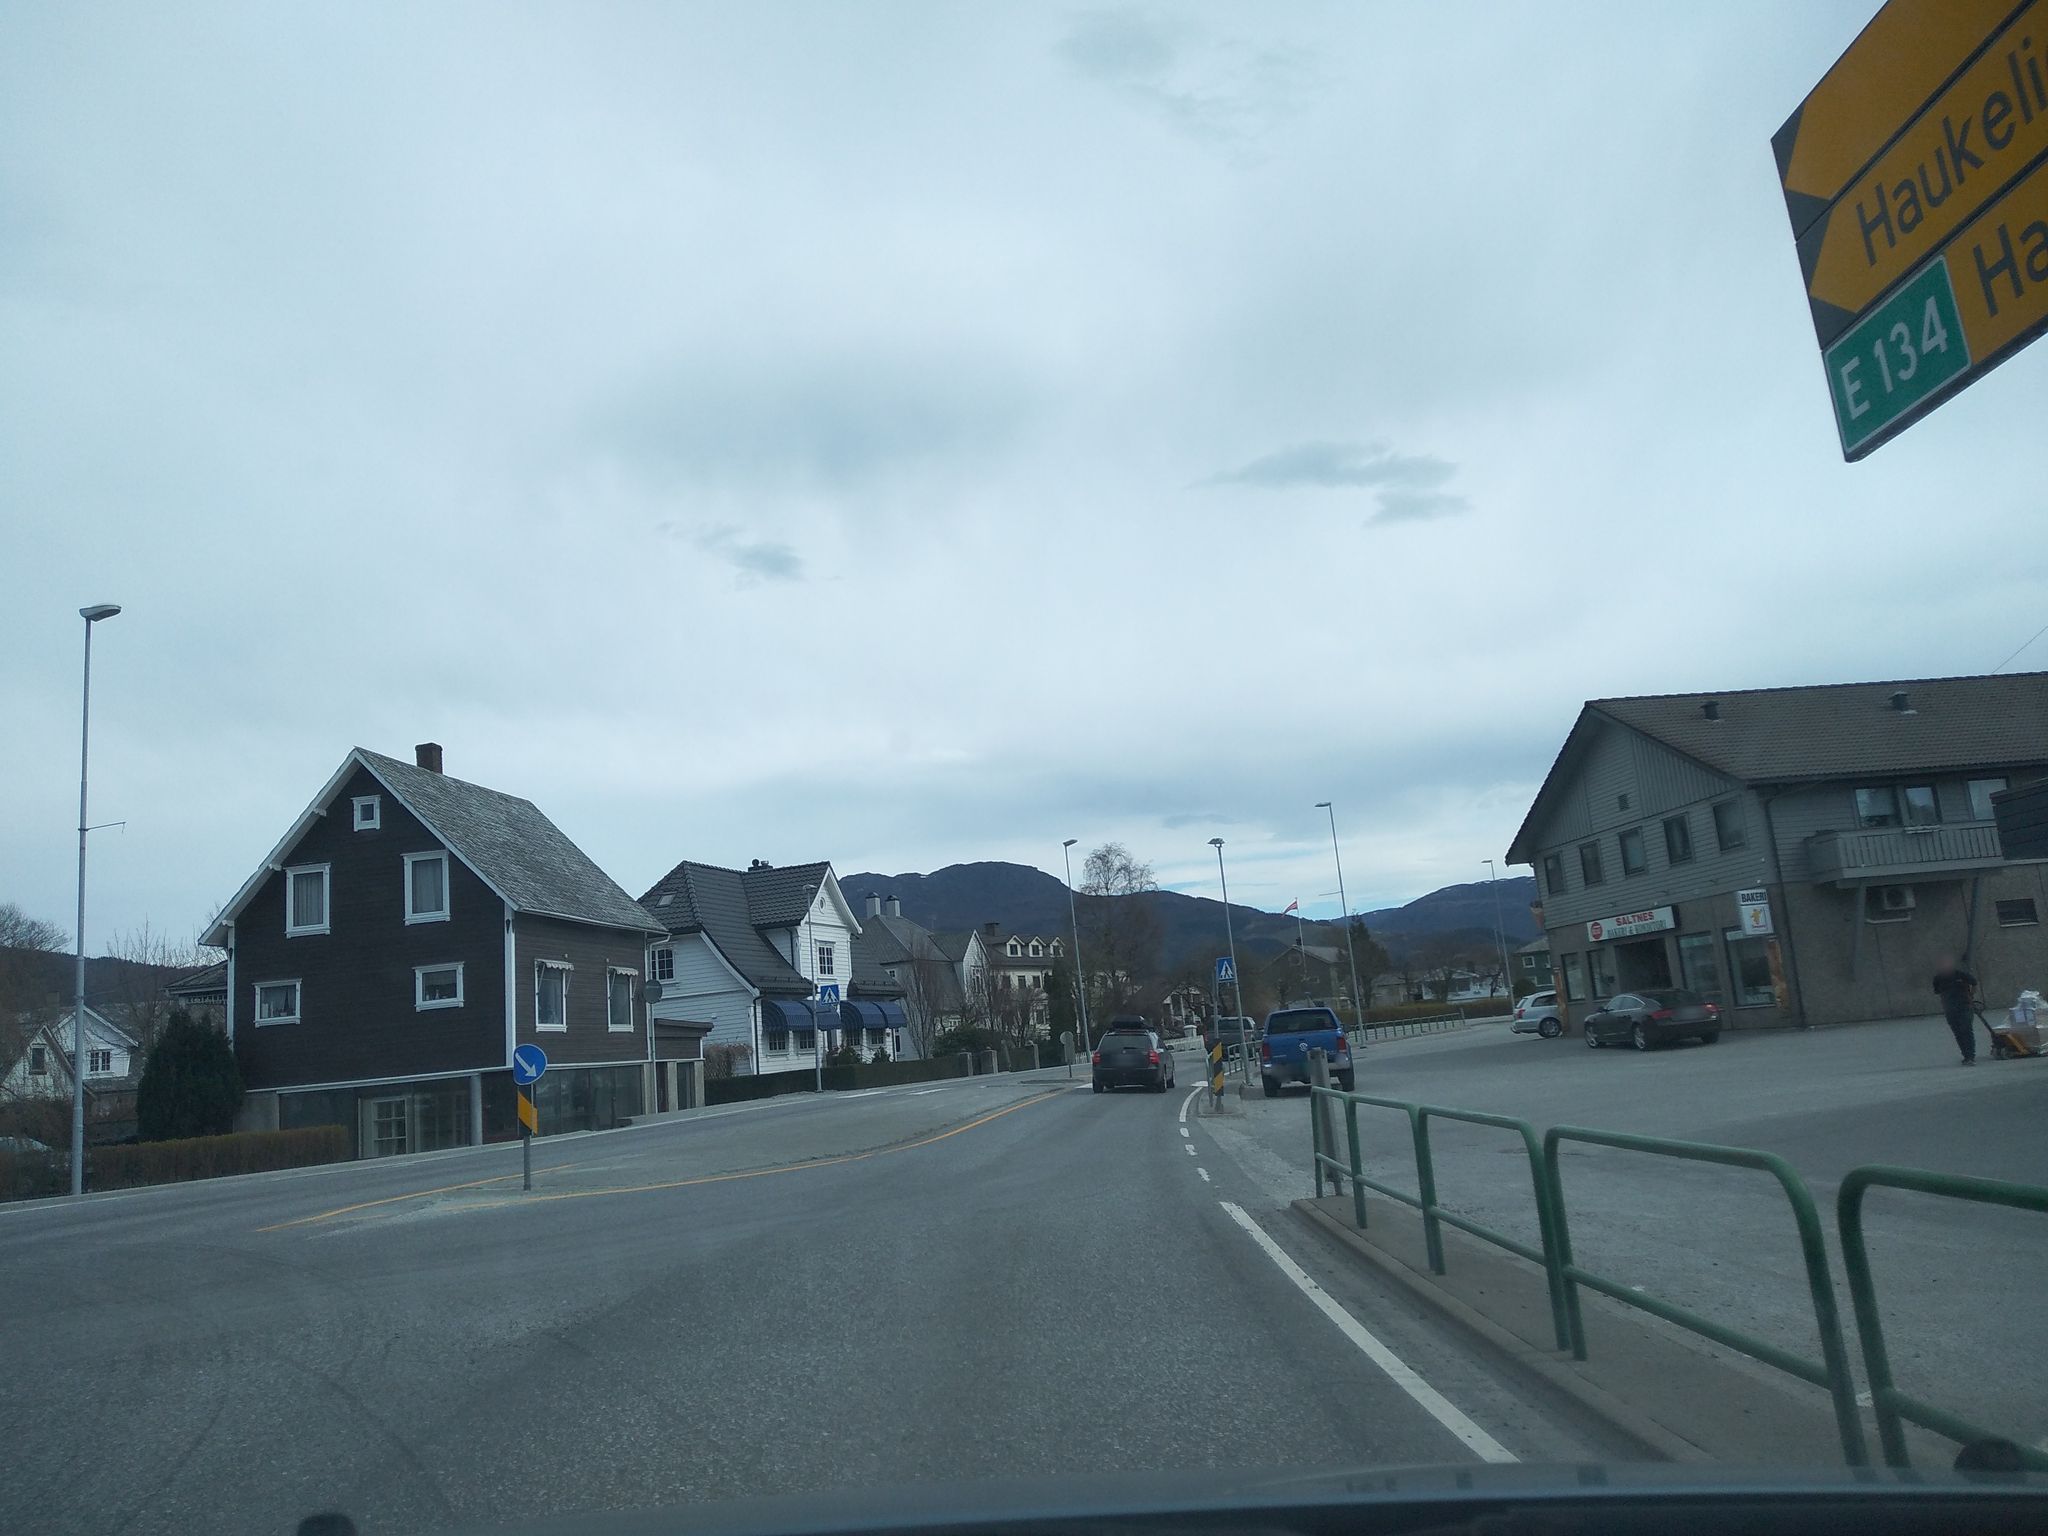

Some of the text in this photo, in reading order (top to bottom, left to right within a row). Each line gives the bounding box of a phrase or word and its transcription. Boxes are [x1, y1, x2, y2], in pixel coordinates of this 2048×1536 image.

[1855, 36, 2048, 266] Haukeli
[1840, 295, 1948, 420] E 134
[1615, 911, 1655, 926] SALTNES
